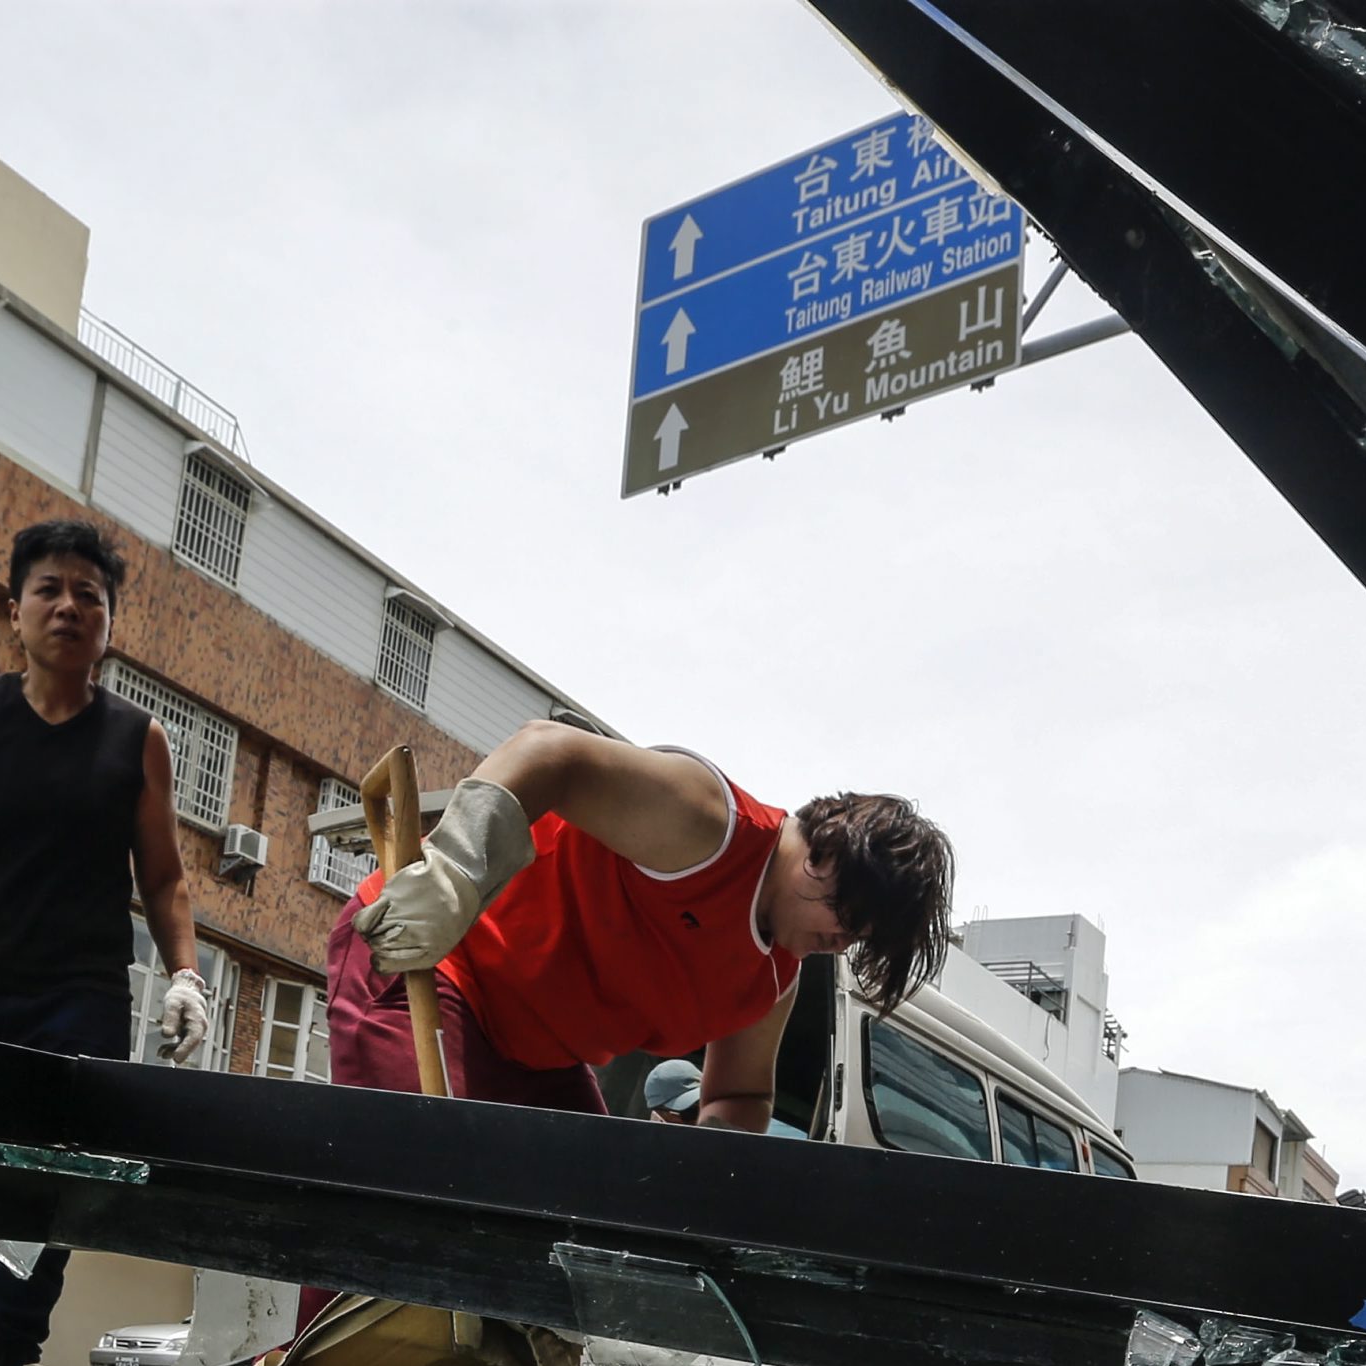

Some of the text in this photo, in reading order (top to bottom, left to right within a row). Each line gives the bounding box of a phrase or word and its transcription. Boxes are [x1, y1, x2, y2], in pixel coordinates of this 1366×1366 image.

[787, 184, 1012, 301] 台東火車站
[792, 178, 897, 234] Taitung
[785, 231, 1012, 334] Taitung Railway Station
[773, 339, 1004, 435] Li Yu Mountain
